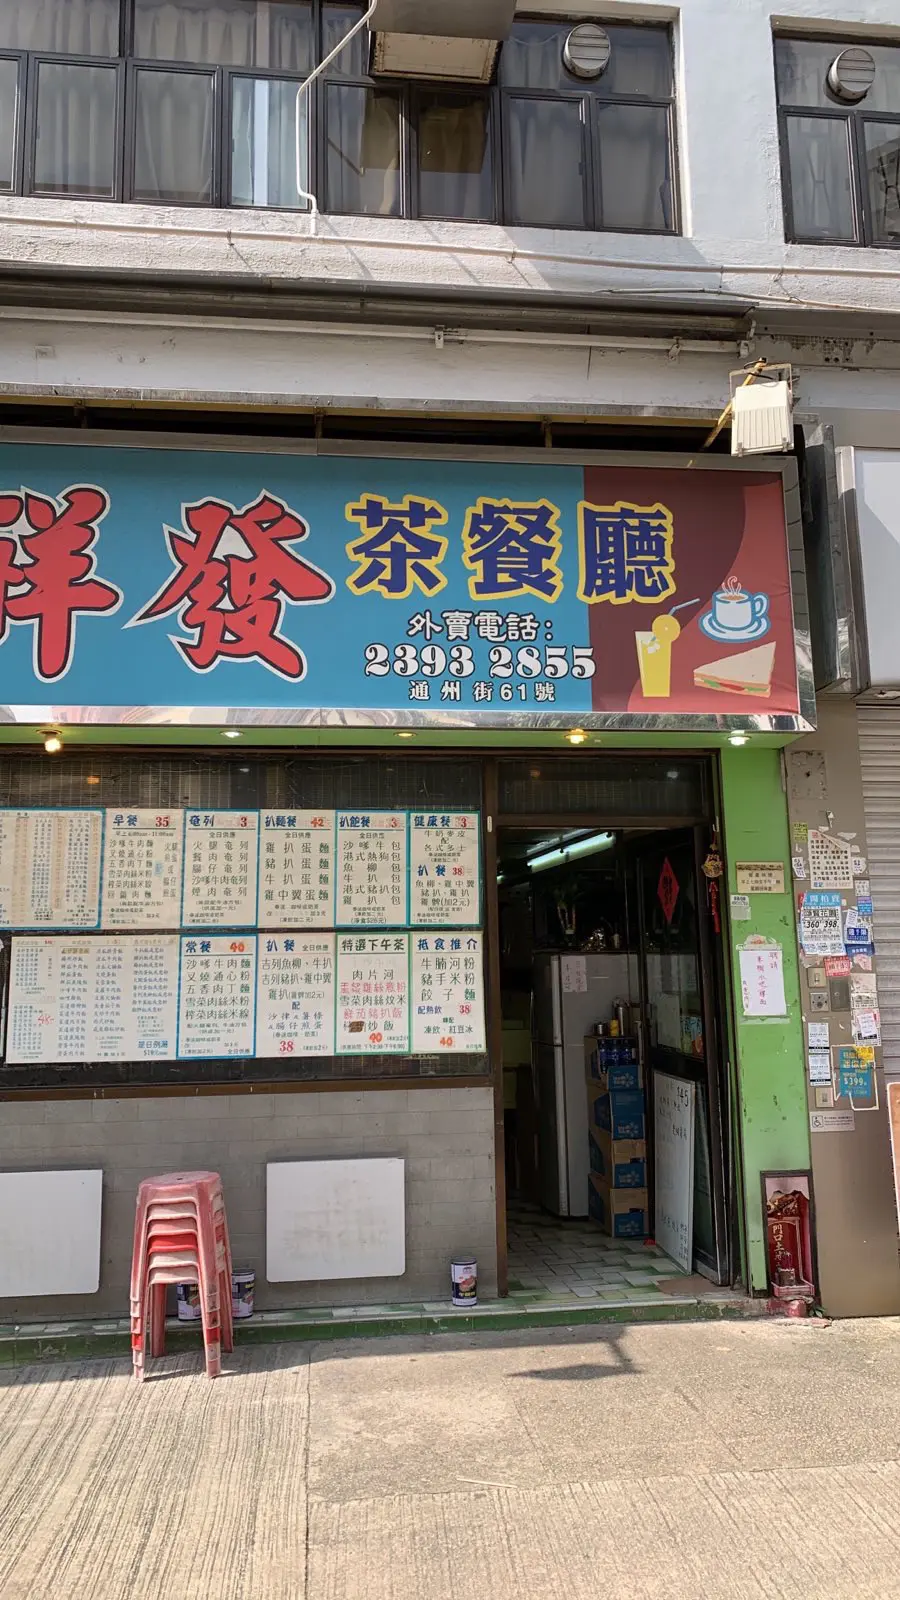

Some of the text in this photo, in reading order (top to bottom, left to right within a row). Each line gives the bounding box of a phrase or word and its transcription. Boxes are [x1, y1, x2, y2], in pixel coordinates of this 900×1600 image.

[345, 493, 677, 605] 茶餐廳
[408, 611, 554, 642] 外賣電話:
[364, 645, 597, 680] 2393 2855
[408, 681, 556, 702] 通州街61號
[113, 814, 170, 828] 早餐 35
[414, 815, 451, 827] 健康餐
[424, 844, 467, 852] 各式多士
[343, 852, 400, 861] 港式熱狗包
[343, 863, 400, 872] 魚柳包
[418, 864, 463, 876] 扒餐 38
[343, 874, 400, 883] 牛扒包
[343, 885, 400, 894] 港式豬扒包
[185, 940, 211, 953] 常餐
[266, 939, 295, 952] 扒餐
[341, 938, 405, 951] 特選下午茶
[421, 957, 475, 970] 牛腩河粉
[352, 969, 394, 981] 肉片河
[421, 973, 475, 986] 豬手米粉
[421, 988, 476, 1001] 餃子麵
[292, 1001, 300, 1010] 配
[459, 1005, 471, 1014] 38
[369, 1032, 382, 1043] 40
[279, 1041, 294, 1052] 38
